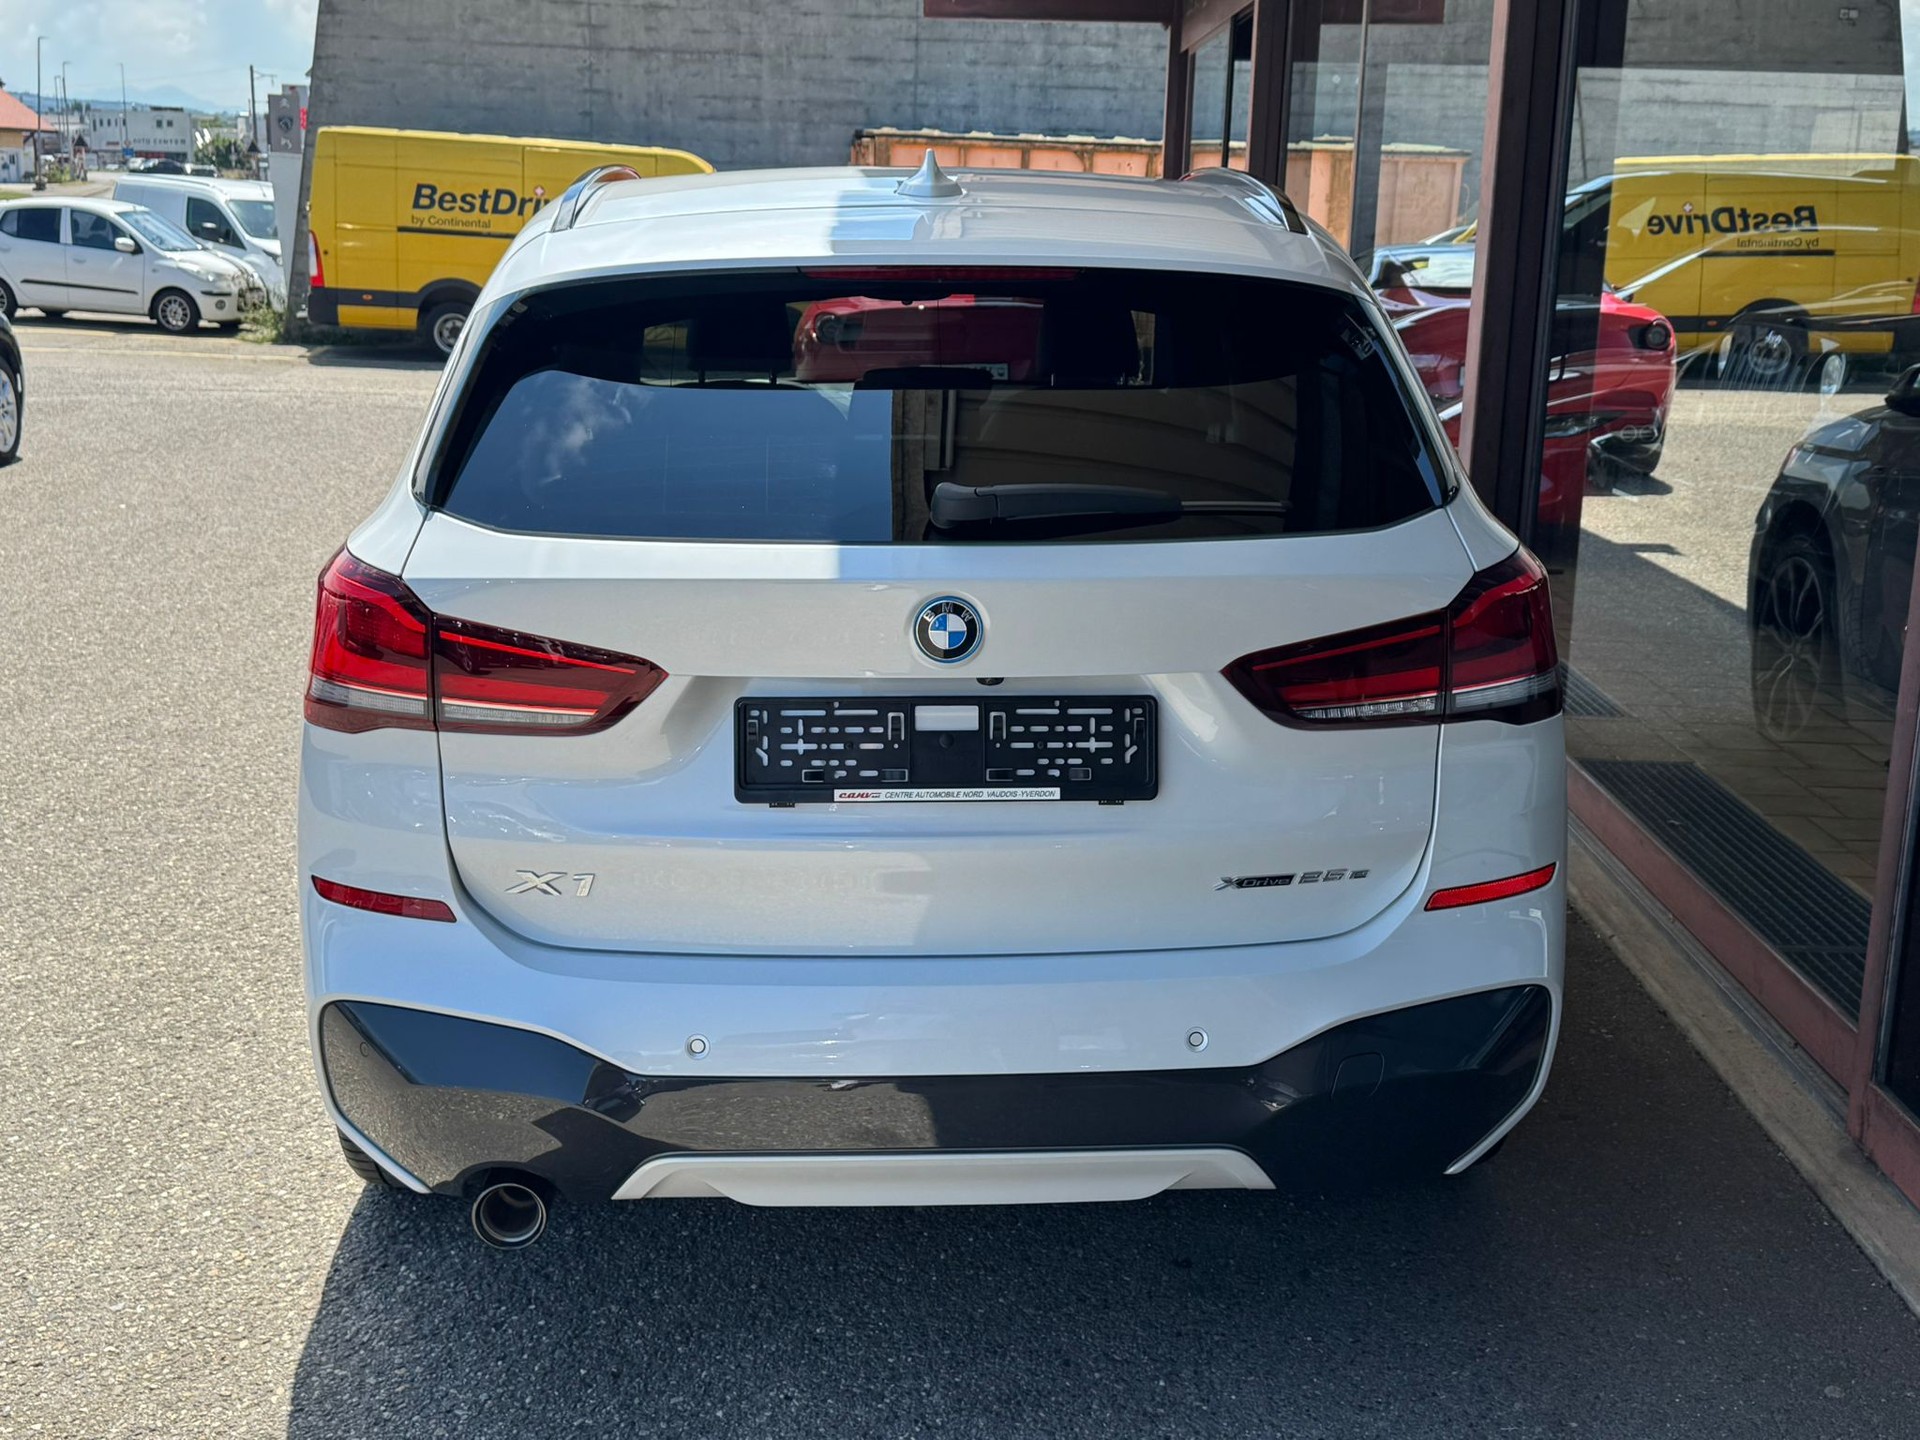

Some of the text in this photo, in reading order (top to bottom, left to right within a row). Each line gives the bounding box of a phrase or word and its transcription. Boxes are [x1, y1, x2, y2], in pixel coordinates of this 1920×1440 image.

[412, 182, 551, 217] BestDri
[411, 214, 491, 229] by Continental
[923, 602, 974, 623] BMW
[884, 791, 914, 799] CENTRE
[914, 791, 961, 799] AUTOMOBILE
[962, 790, 985, 798] NORD
[503, 869, 596, 897] X1
